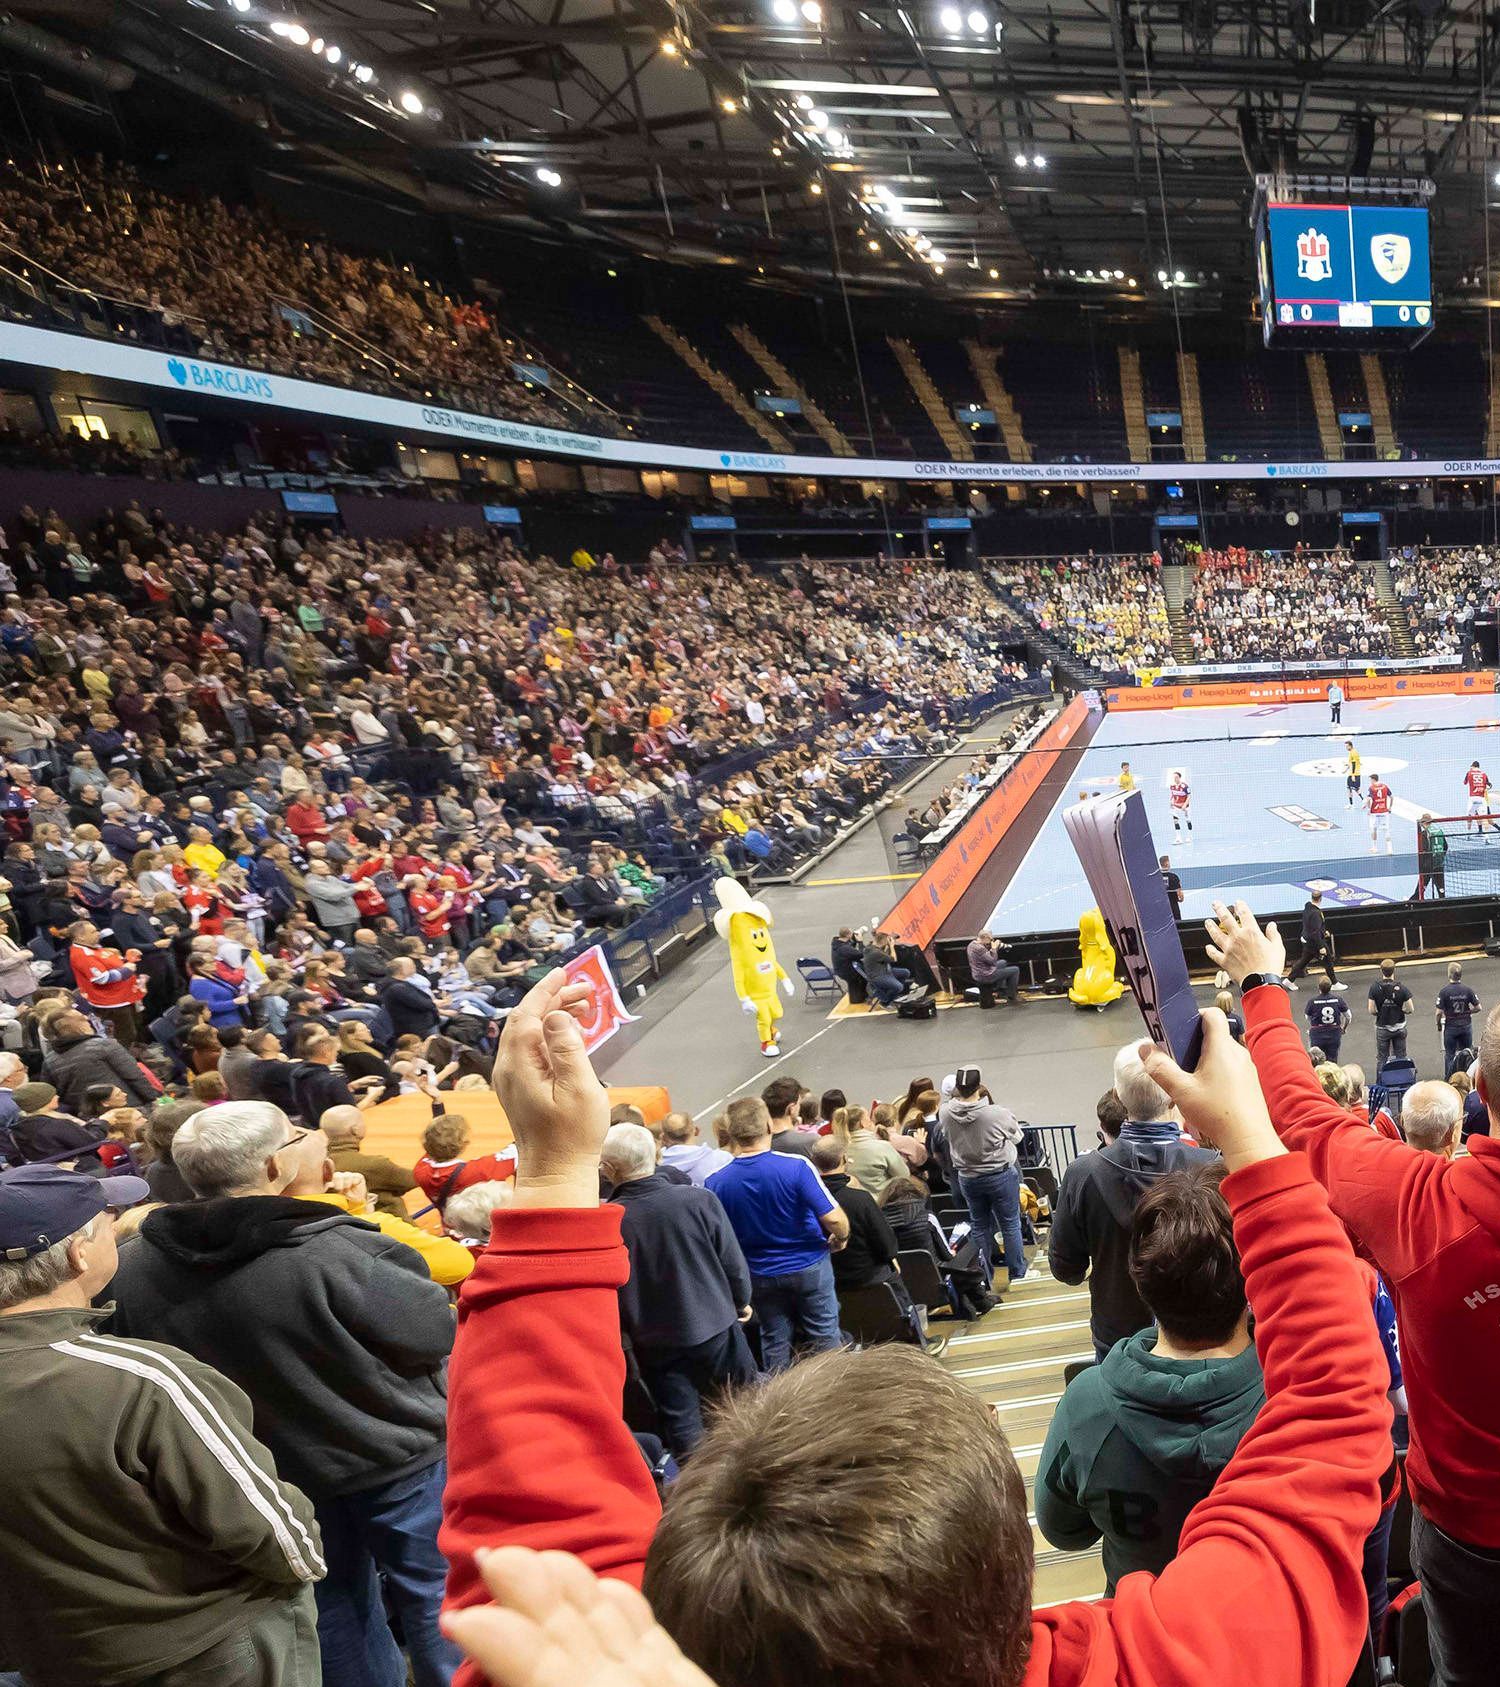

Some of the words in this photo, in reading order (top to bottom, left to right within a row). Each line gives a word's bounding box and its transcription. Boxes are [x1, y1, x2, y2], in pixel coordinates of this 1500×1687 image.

[1300, 304, 1313, 320] 0
[1399, 306, 1411, 322] 0
[190, 364, 273, 399] BARCLAYS
[734, 455, 786, 469] BARCLAYS
[1444, 462, 1472, 472] ODER
[914, 463, 947, 475] ODER
[949, 464, 1000, 476] Momente
[1002, 464, 1044, 478] erleben,
[1046, 464, 1062, 477] die
[1063, 465, 1080, 477] nie
[1082, 465, 1141, 477] verblassen?
[1279, 464, 1328, 476] BARCLAYS
[1321, 1006, 1335, 1024] 8
